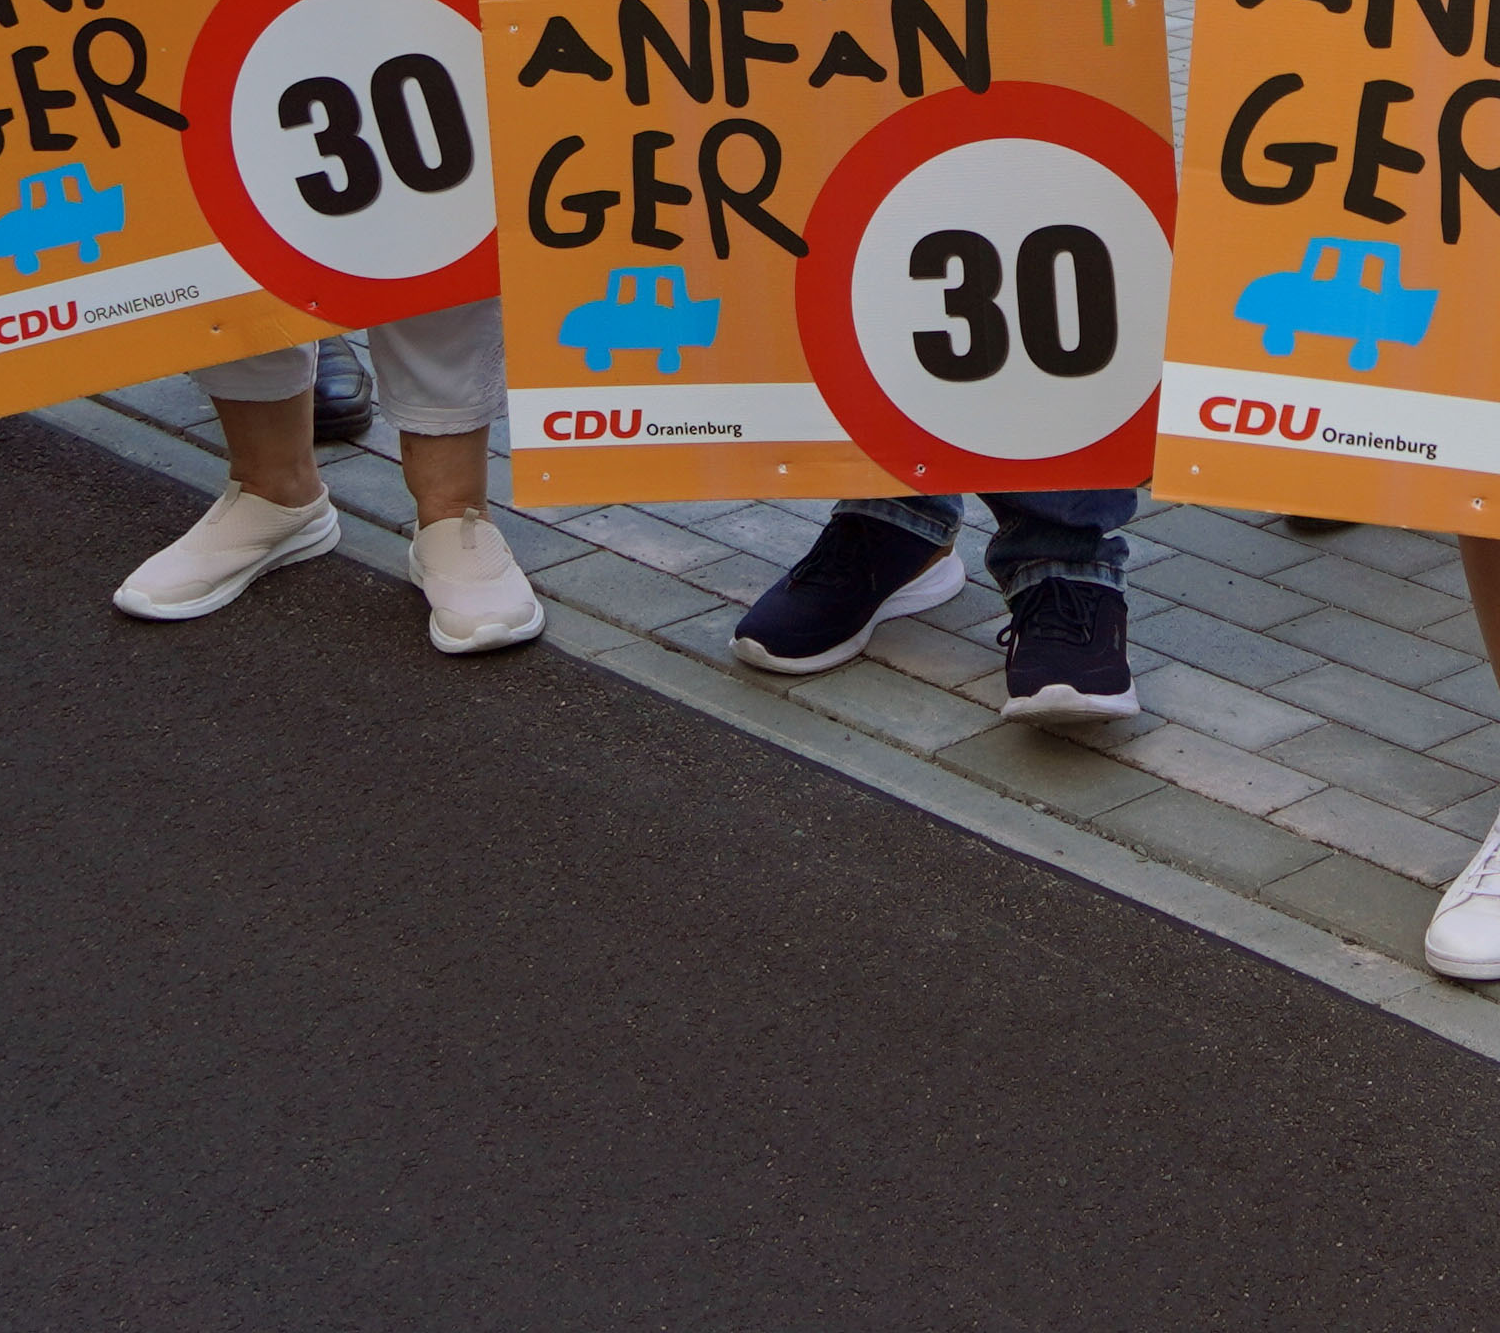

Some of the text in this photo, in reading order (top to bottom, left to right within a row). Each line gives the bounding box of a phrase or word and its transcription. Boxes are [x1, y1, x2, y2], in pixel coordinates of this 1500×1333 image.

[277, 52, 474, 216] 30
[528, 118, 809, 260] GER
[84, 285, 200, 324] ORANIENBURG
[908, 224, 1117, 382] 30
[543, 409, 742, 441] CDU Oranienburg
[1199, 396, 1438, 460] CDU Oranienburg
